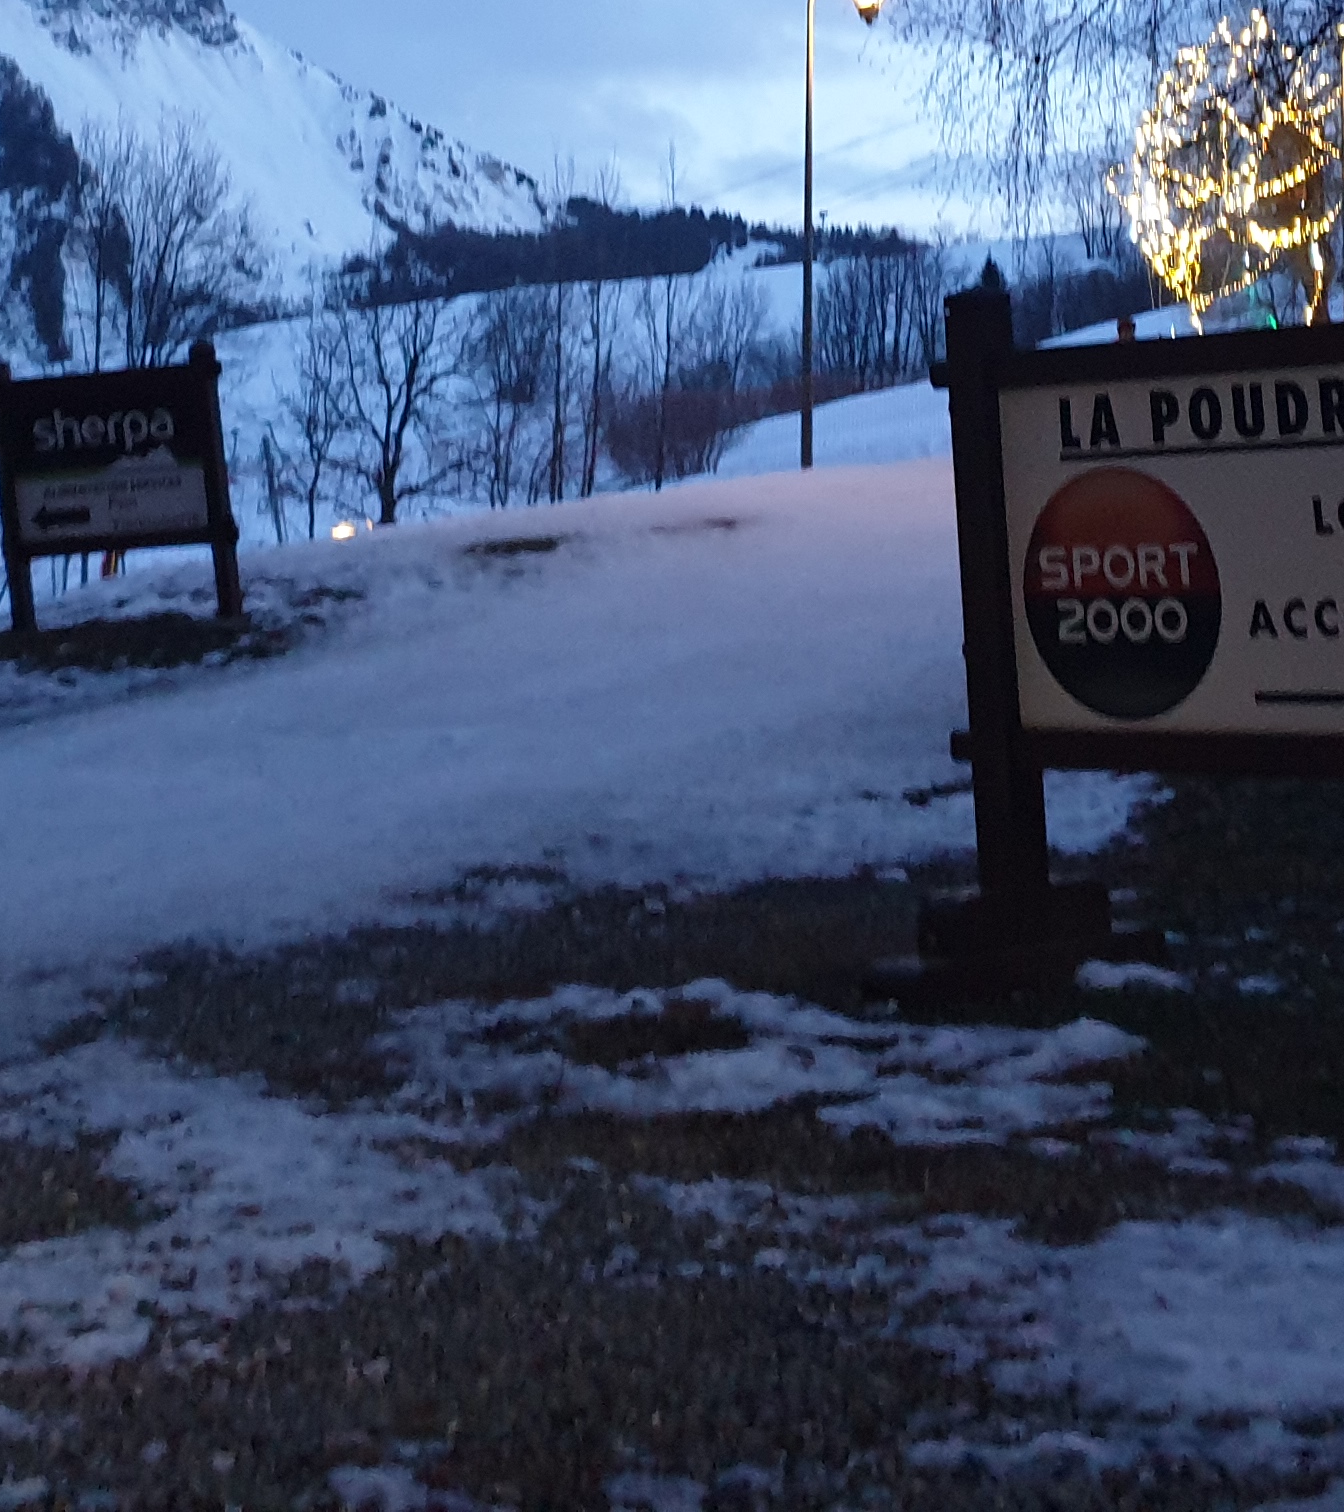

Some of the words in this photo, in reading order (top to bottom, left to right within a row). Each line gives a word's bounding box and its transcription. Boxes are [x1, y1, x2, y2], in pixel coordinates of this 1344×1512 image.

[32, 407, 175, 452] sherpa
[1059, 392, 1121, 449] LA
[1039, 542, 1199, 589] SPORT
[1059, 597, 1188, 644] 2000
